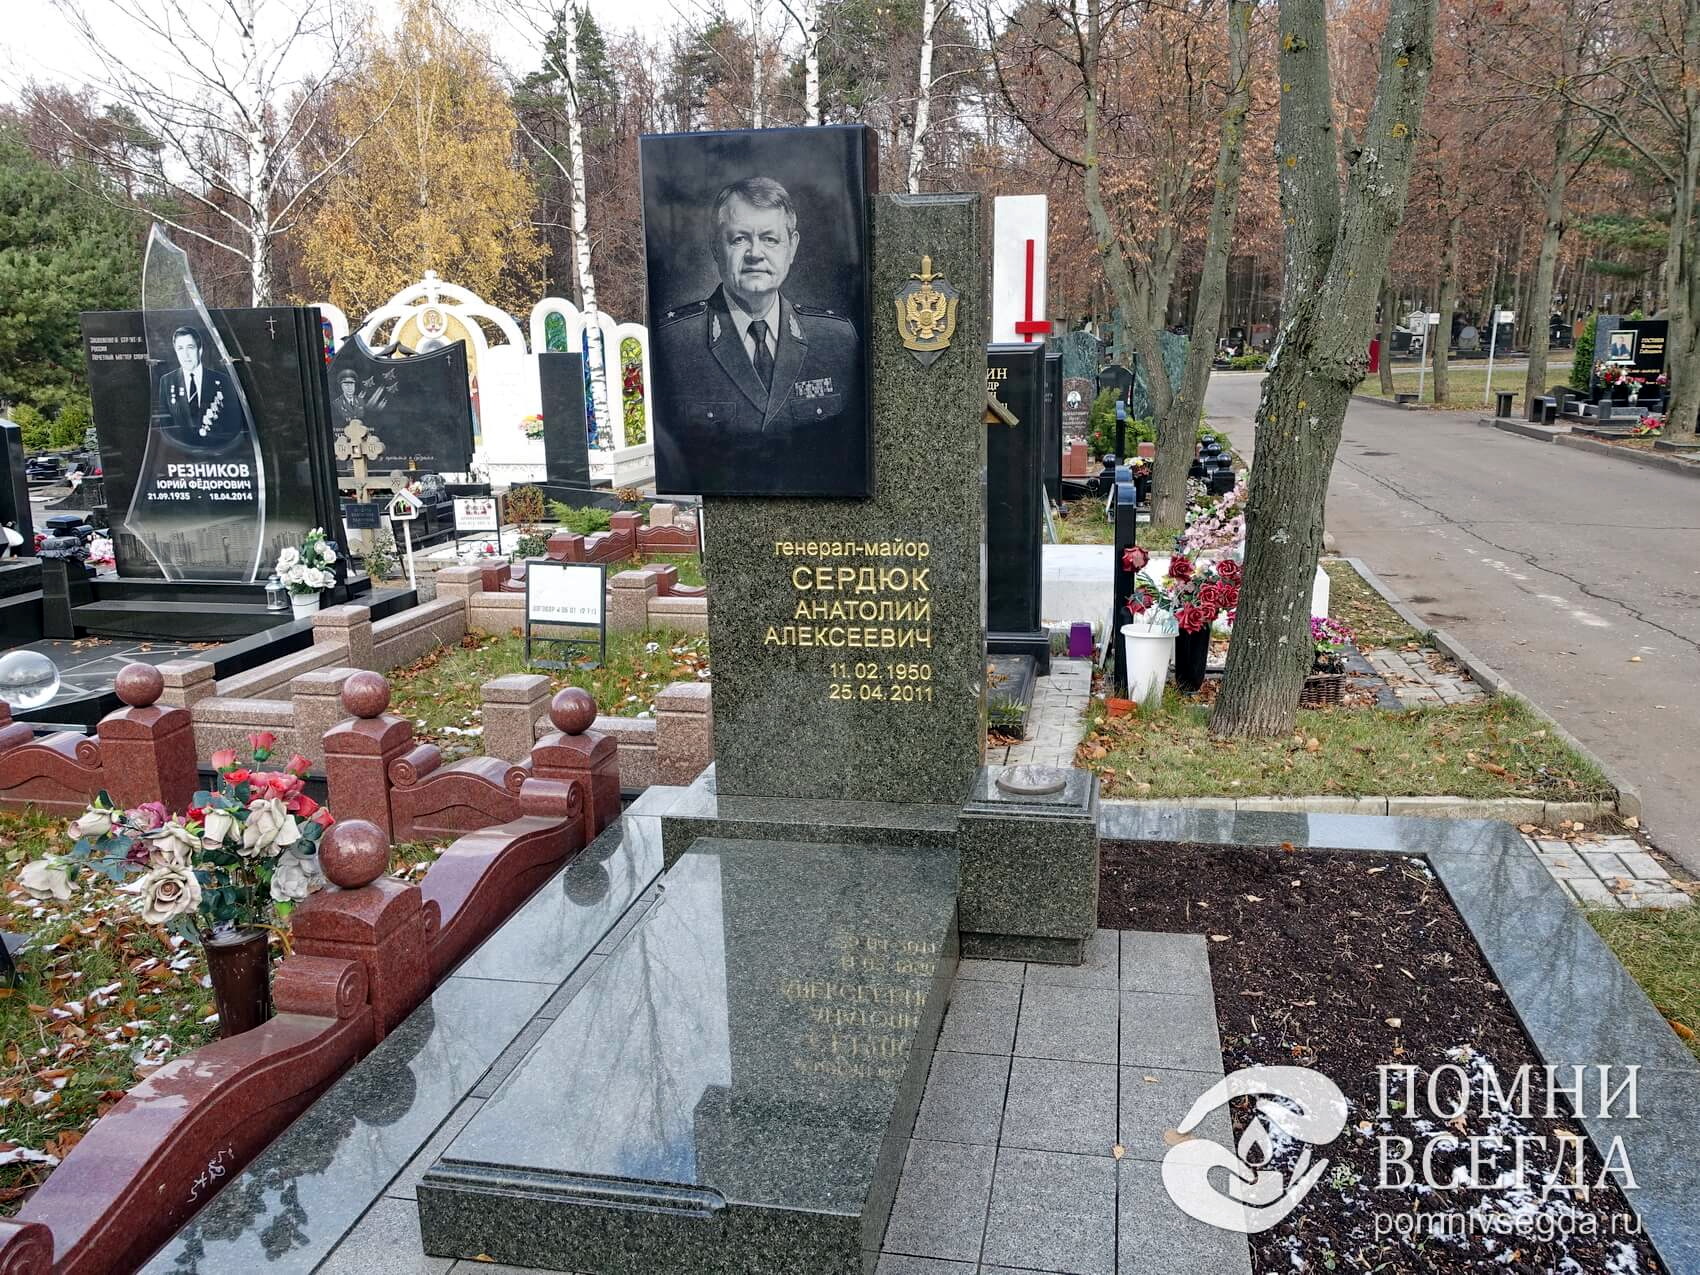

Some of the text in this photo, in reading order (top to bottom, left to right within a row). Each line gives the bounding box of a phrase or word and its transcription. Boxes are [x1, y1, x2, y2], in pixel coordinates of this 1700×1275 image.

[167, 463, 250, 478] РЕЗНИКОВ
[156, 479, 252, 490] ЮРИЙ ФЁДОРОВИЧ
[147, 492, 191, 501] 21.09.1935
[209, 492, 253, 501] 18.04.2014
[775, 538, 930, 561] генерал-майор
[792, 565, 931, 595] СЕРДЮК
[794, 597, 931, 622] АНАТОЛИЙ
[763, 625, 932, 649] АЛЕКСЕЕВИЧ
